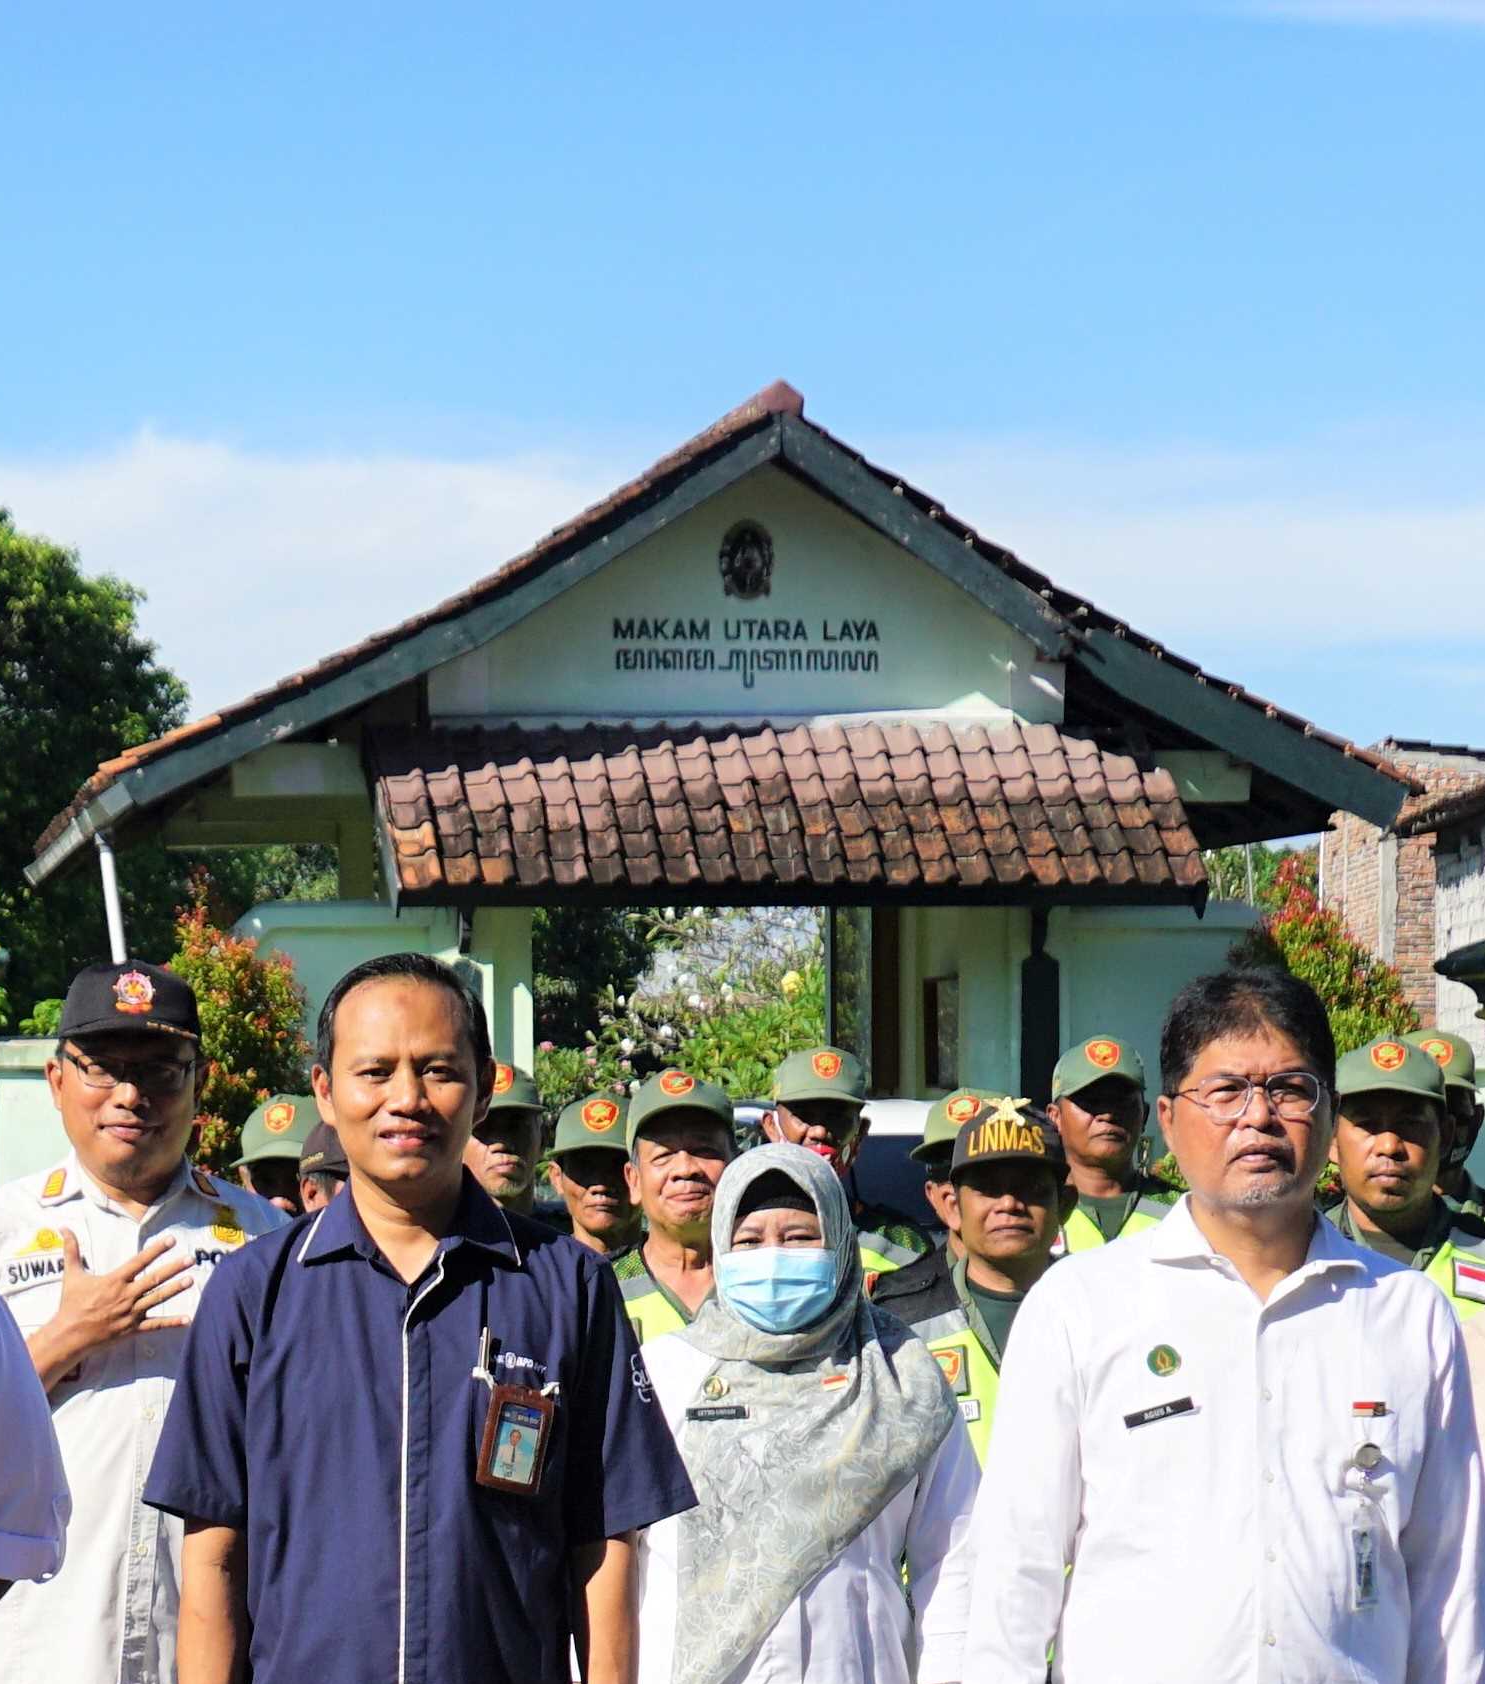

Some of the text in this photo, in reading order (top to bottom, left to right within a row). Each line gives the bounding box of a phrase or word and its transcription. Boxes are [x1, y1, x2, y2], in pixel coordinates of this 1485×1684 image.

[612, 617, 881, 642] MAKAM UTARA LAYA
[968, 1118, 1046, 1157] LINMAS
